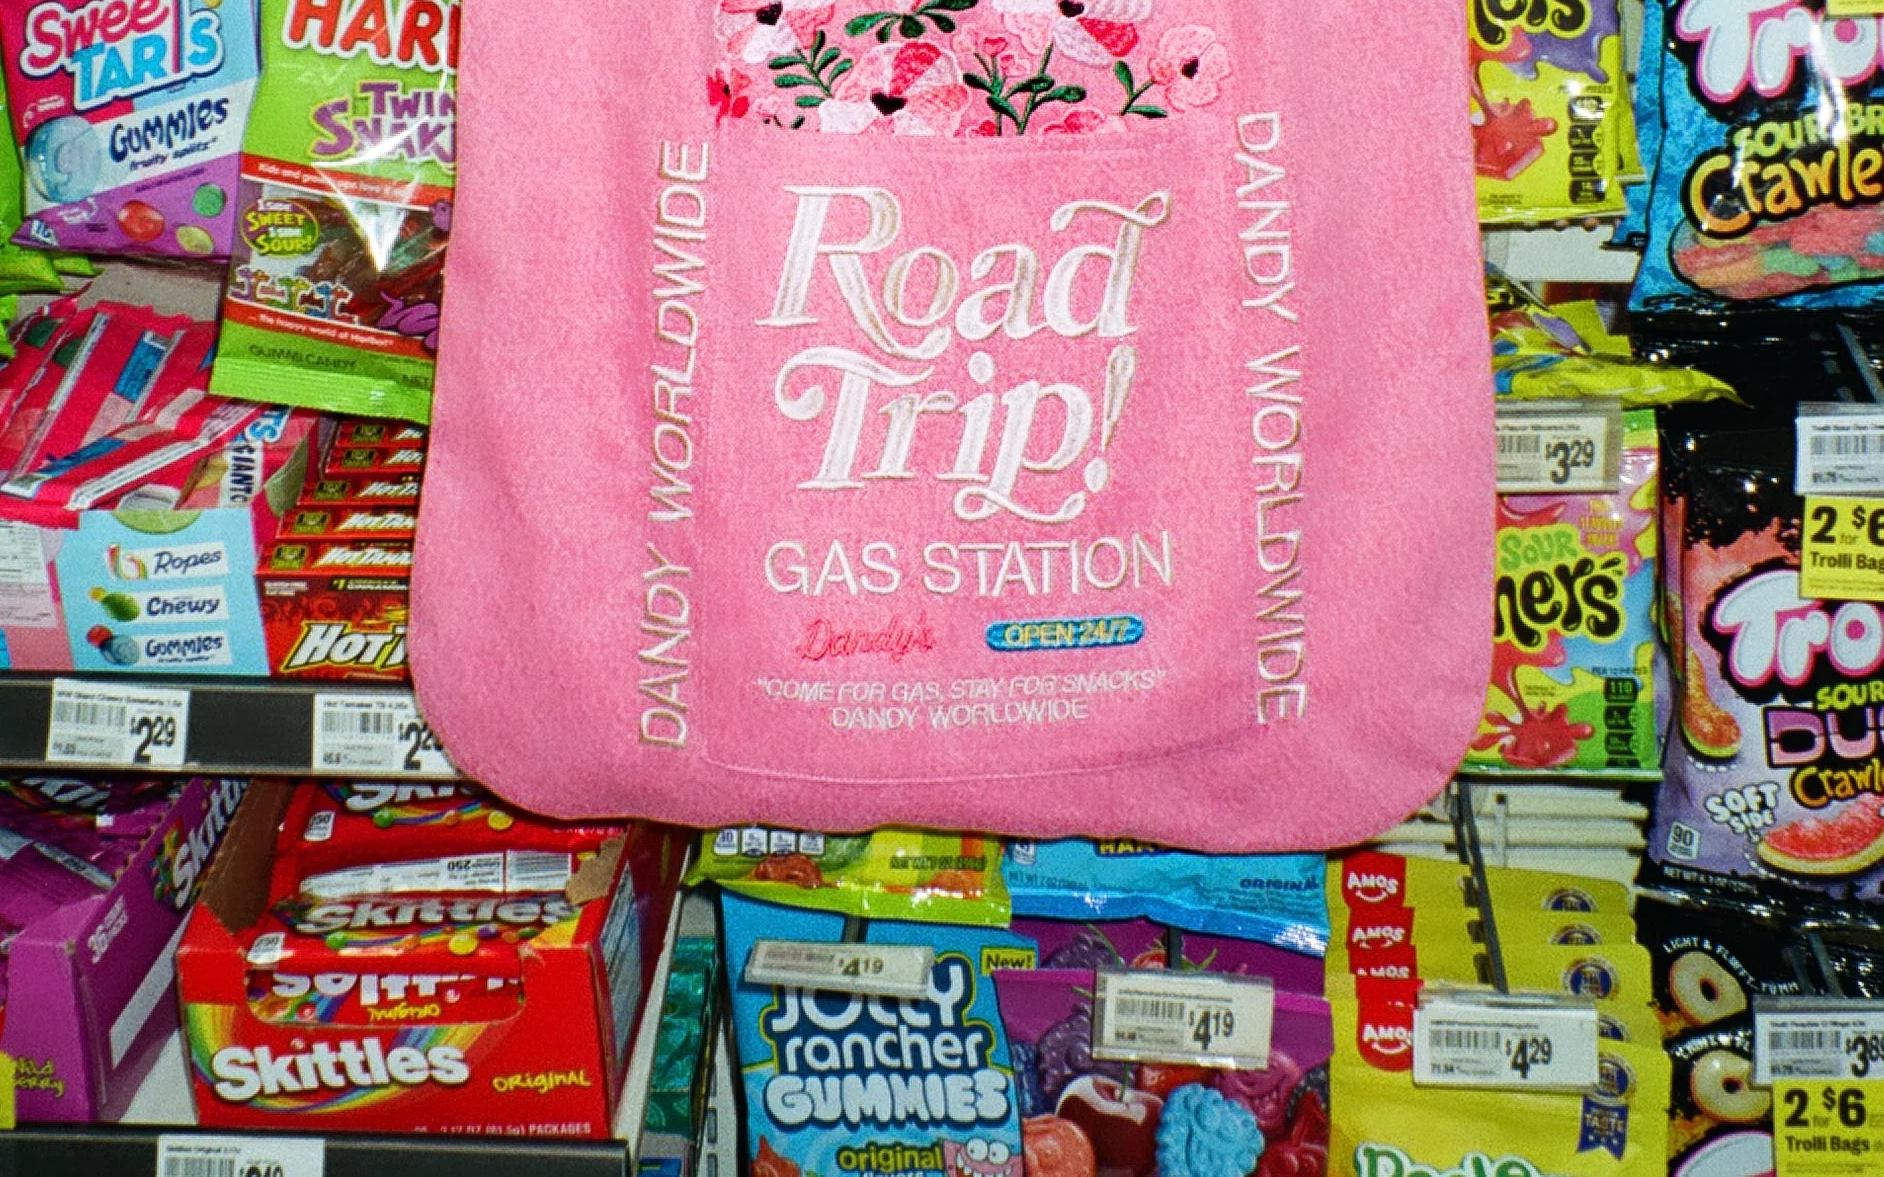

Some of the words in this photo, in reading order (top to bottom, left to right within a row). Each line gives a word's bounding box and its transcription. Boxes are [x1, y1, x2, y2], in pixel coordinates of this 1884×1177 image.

[130, 153, 168, 171] fruity
[258, 162, 279, 174] Kids
[281, 167, 301, 179] and
[246, 209, 306, 230] SWEET
[1235, 110, 1300, 326] DANDY
[256, 234, 313, 255] SOUR!
[755, 185, 1171, 360] Road
[276, 316, 308, 332] happy
[309, 323, 337, 337] world
[338, 330, 349, 340] of
[646, 140, 711, 525] WORLDWIDE
[249, 343, 304, 364] GUMMI
[307, 351, 357, 371] CANDY
[402, 373, 430, 390] NET
[775, 345, 1138, 523] Trip!
[1243, 341, 1308, 725] WORLDWIDE
[1811, 505, 1838, 544] 2
[1839, 533, 1858, 545] for
[154, 549, 223, 575] Ropes
[764, 539, 903, 597] GAS
[923, 530, 1175, 597] STATION
[1500, 530, 1578, 572] SOUR
[1810, 551, 1853, 569] Trolli
[146, 595, 221, 618] Chewy
[289, 621, 393, 669] HOT
[639, 542, 693, 750] DANDY
[795, 613, 936, 662] Dandy's
[1004, 620, 1073, 647] OPEN
[1078, 618, 1132, 642] 24/7
[756, 676, 834, 701] "COME
[837, 679, 885, 702] FOR
[891, 679, 946, 702] GAS,
[951, 676, 1004, 701] STAY
[1009, 674, 1056, 698] FOR
[1062, 668, 1166, 694] SNACKS"
[1609, 679, 1633, 694] 110
[1815, 681, 1884, 711] SOUR
[831, 706, 919, 730] DANDY
[929, 697, 1089, 729] WORLDWIDE
[1706, 782, 1779, 823] SOFT
[1672, 825, 1694, 847] 90
[1729, 809, 1775, 835] SIDE
[1239, 876, 1320, 891] ORIGINAL
[1347, 872, 1399, 895] AMOS
[1664, 866, 1681, 879] NET
[1683, 869, 1697, 882] WT
[299, 899, 576, 933] Skittles
[1351, 926, 1405, 943] AMOS
[1662, 936, 1700, 954] LIGHT
[1703, 938, 1712, 950] &
[985, 953, 1033, 970] New!
[784, 1024, 984, 1072] rancher
[212, 1037, 471, 1102] Skittles
[766, 1068, 1009, 1124] GUMMIES
[1783, 1088, 1809, 1128] 2
[1822, 1086, 1866, 1128] $6
[528, 1121, 591, 1136] PACKAGES
[1585, 1115, 1625, 1131] TASTE
[838, 1144, 942, 1173] original
[1785, 1136, 1827, 1152] Trolli
[1829, 1136, 1870, 1156] Bags
